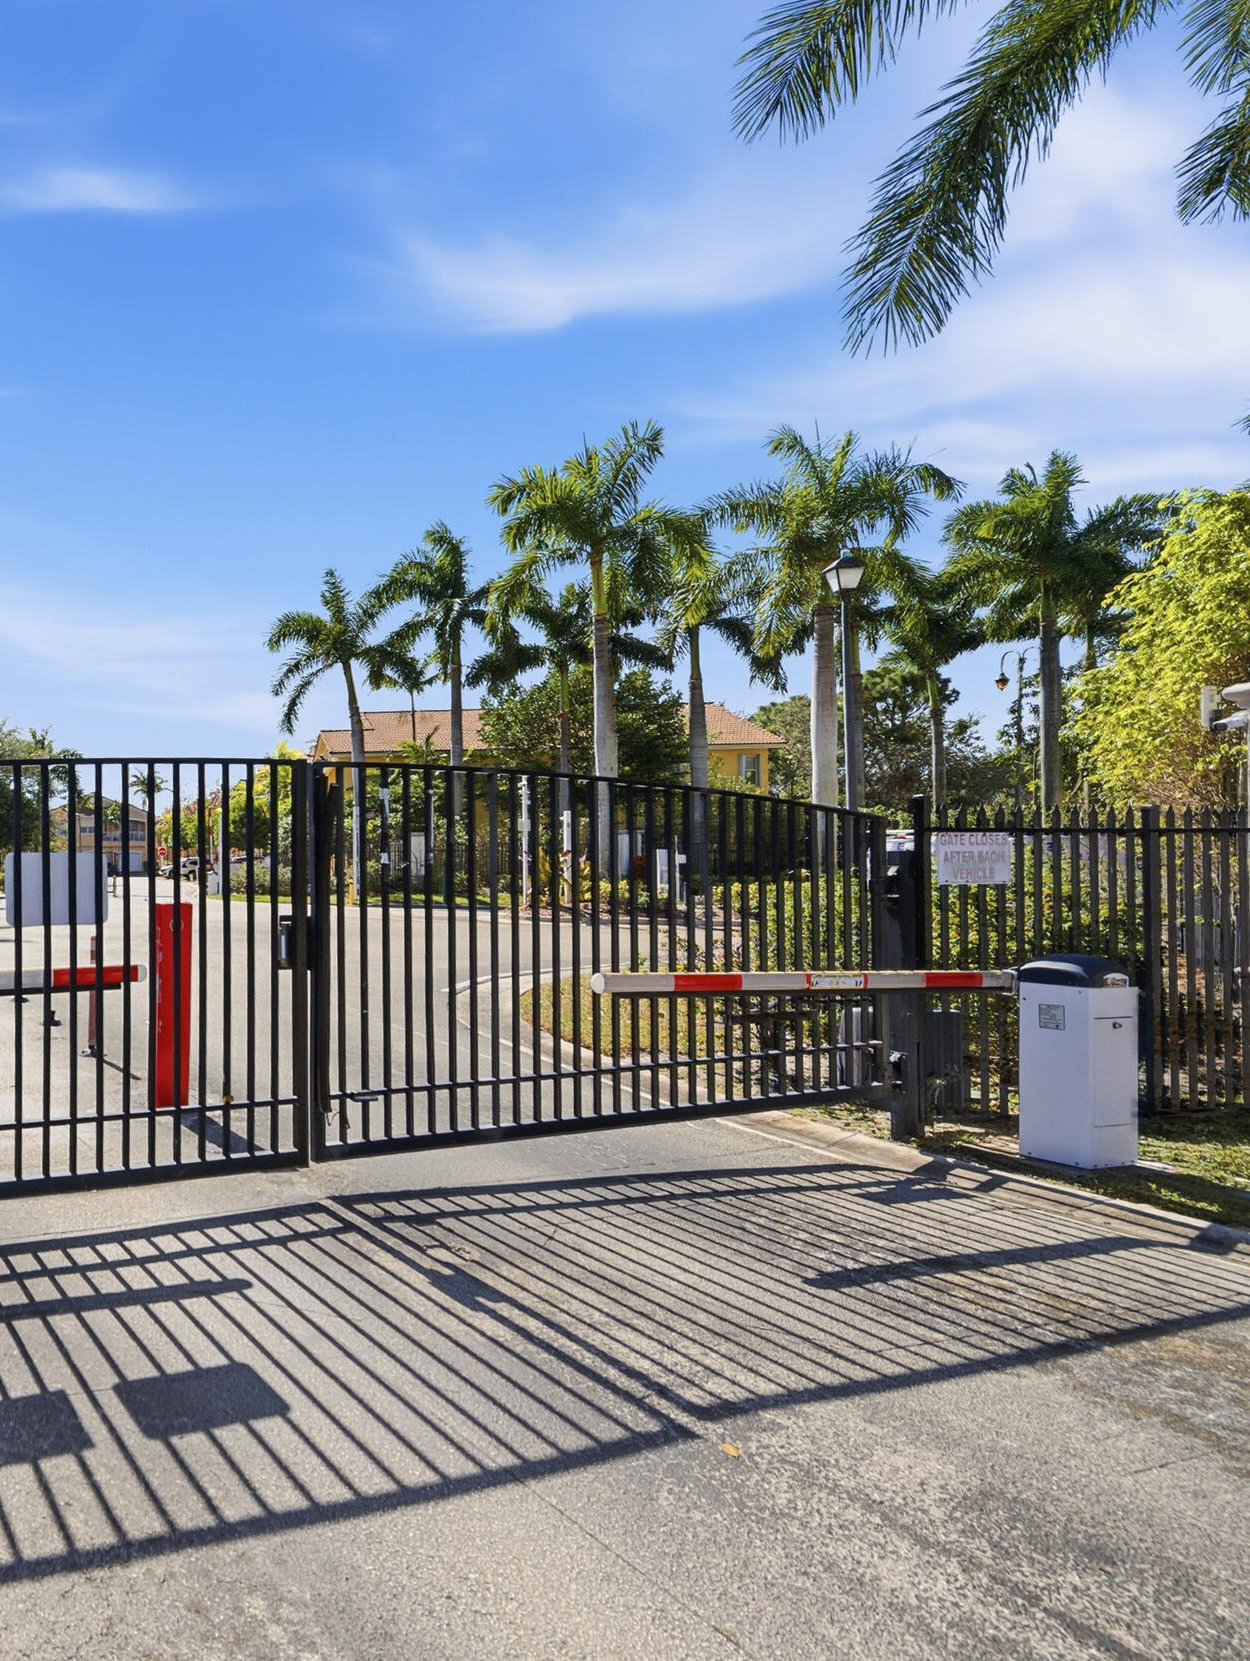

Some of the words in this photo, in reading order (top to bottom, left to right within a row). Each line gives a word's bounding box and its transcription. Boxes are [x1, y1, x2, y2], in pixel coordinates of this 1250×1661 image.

[940, 833, 966, 846] GATE
[968, 833, 1007, 846] CLOSES
[943, 850, 974, 864] AFTER
[952, 867, 995, 880] VEHICLE
